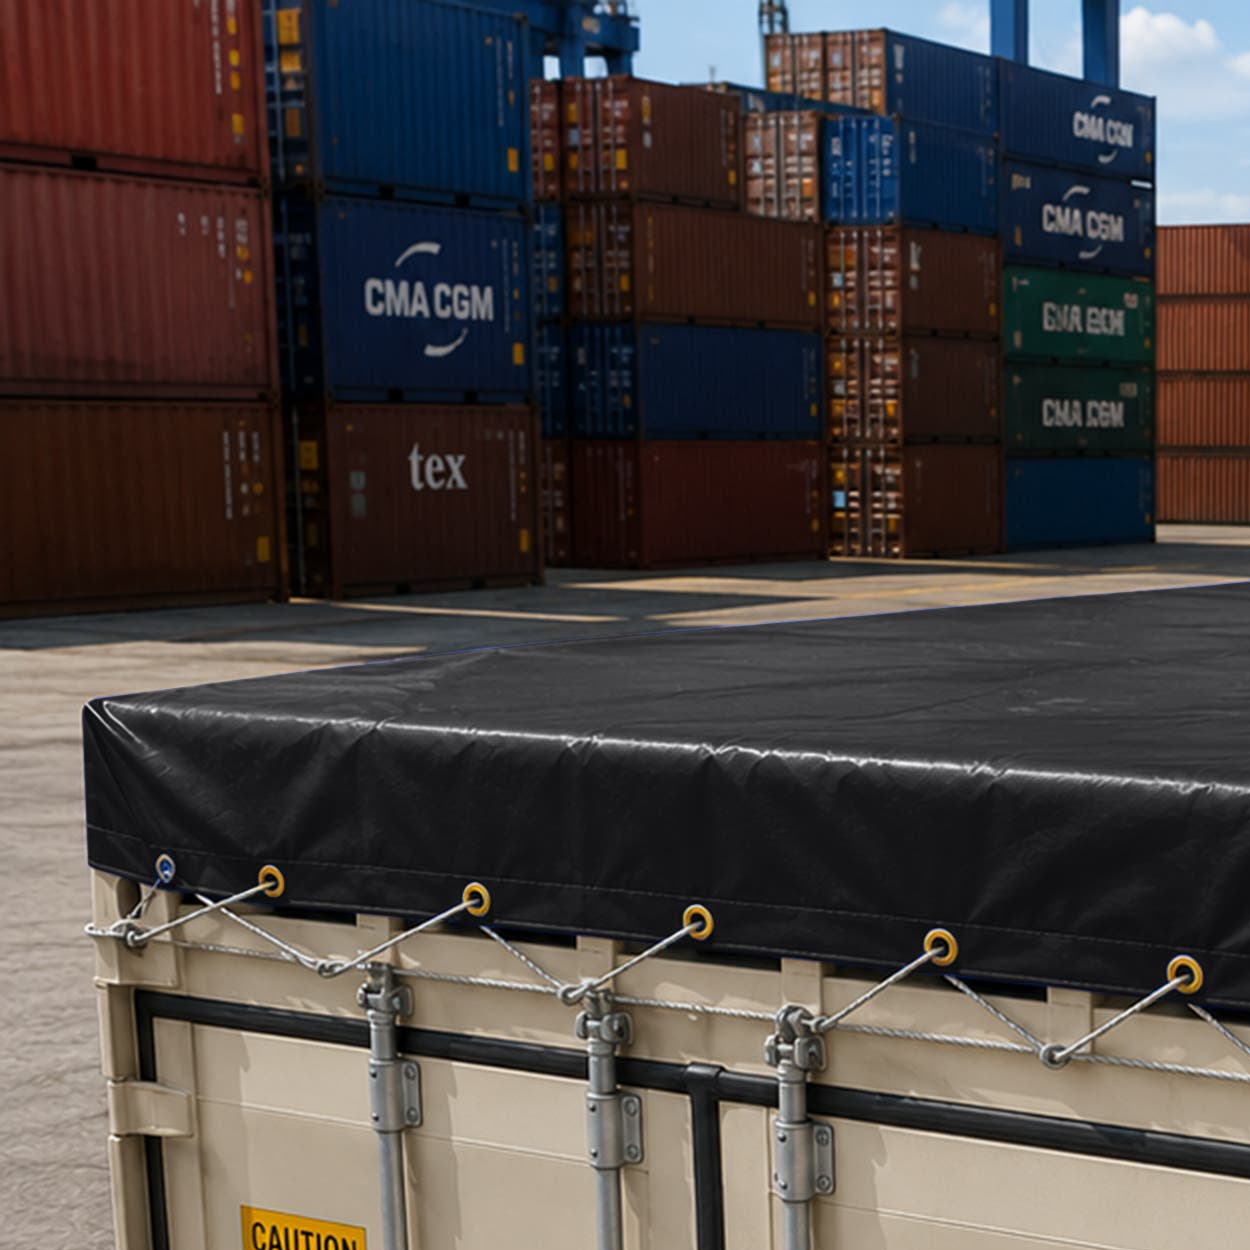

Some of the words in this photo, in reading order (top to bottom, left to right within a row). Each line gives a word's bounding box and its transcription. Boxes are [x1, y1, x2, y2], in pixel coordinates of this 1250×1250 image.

[365, 277, 430, 319] CMA
[433, 283, 495, 322] CGM
[408, 442, 469, 492] tex
